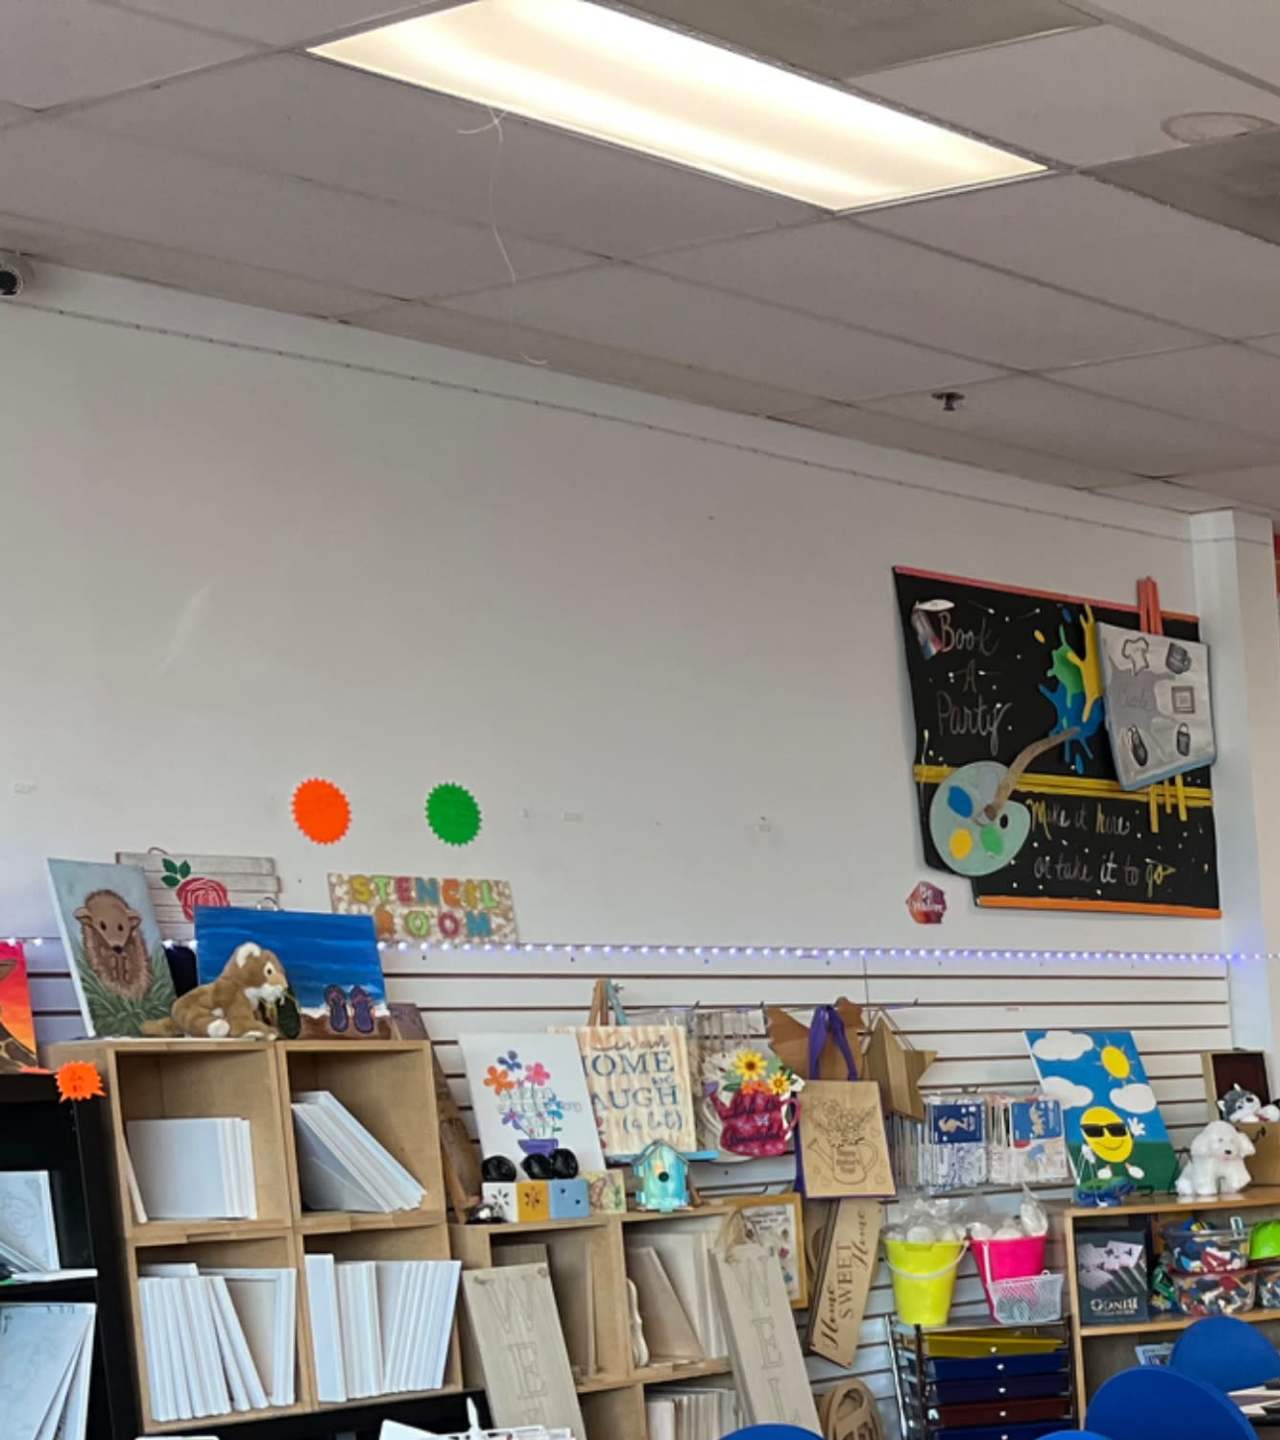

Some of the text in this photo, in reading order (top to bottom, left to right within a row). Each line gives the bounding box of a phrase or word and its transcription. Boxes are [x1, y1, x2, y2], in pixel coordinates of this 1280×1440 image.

[939, 612, 1000, 654] Book
[961, 660, 977, 693] A
[937, 691, 1012, 756] Party
[349, 874, 498, 910] STENCIL
[839, 1243, 854, 1319] SWEET
[820, 1282, 839, 1347] Home
